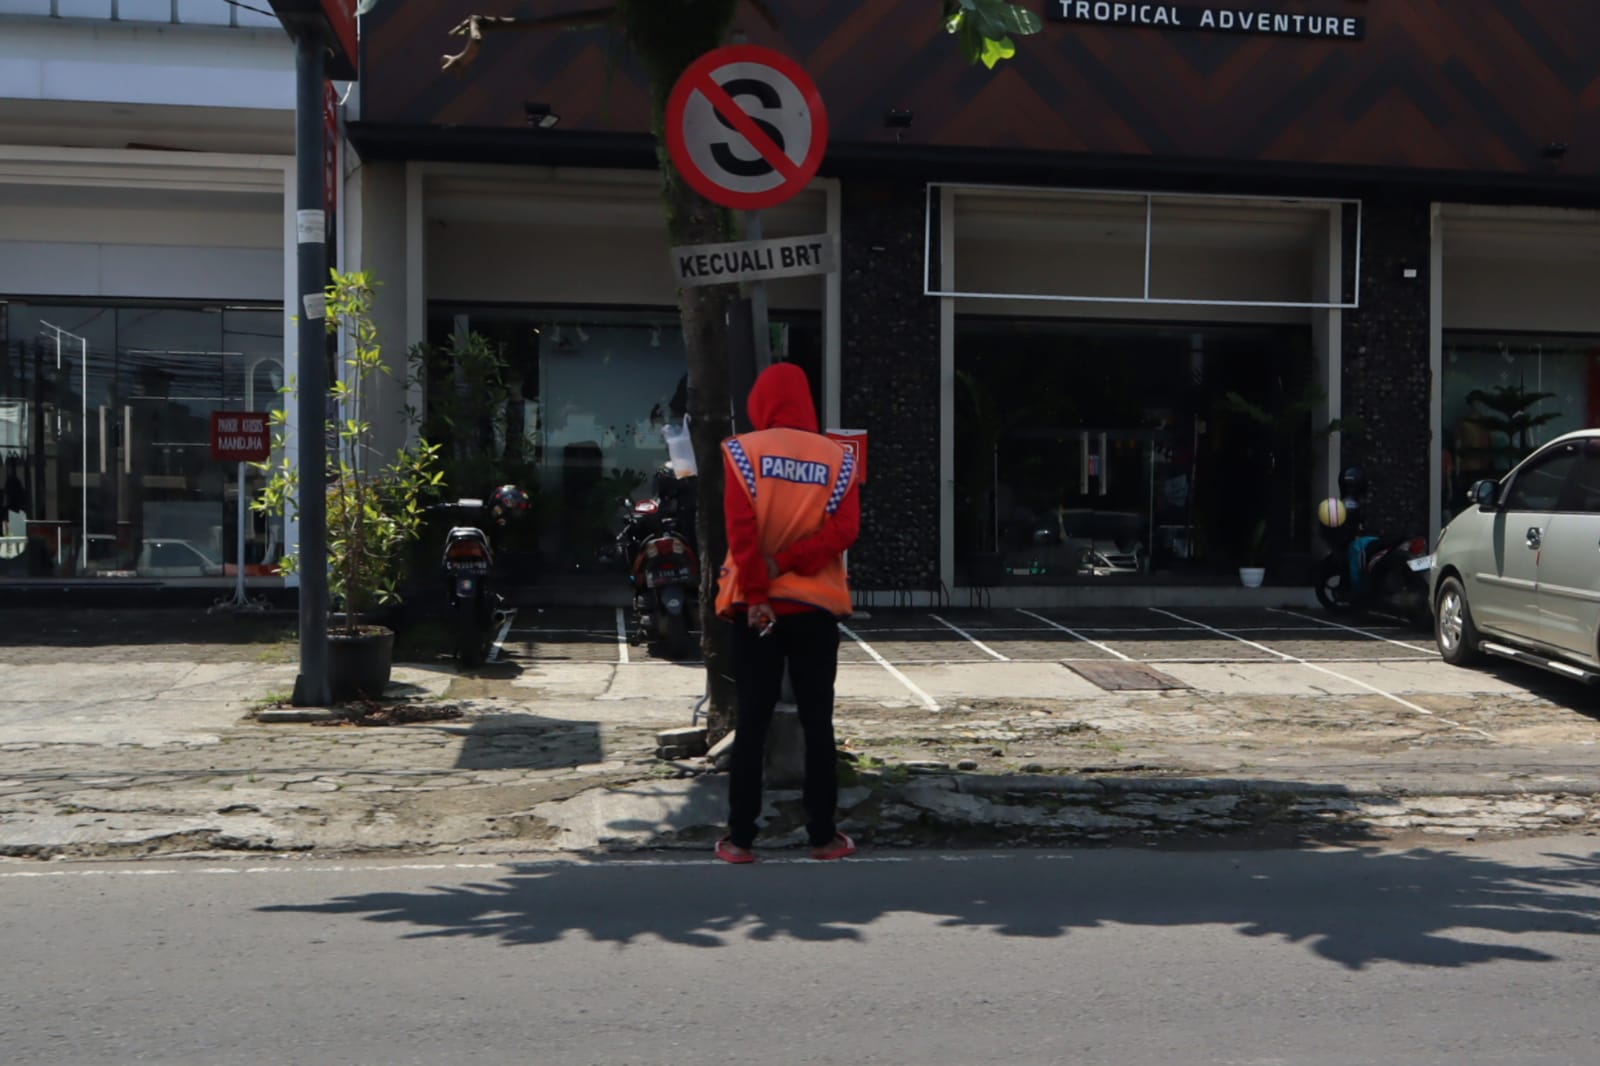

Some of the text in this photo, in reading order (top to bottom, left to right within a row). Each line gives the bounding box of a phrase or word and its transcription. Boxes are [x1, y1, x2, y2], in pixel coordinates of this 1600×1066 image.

[1060, 0, 1356, 36] TROPICAL ADVENTURE
[679, 243, 822, 278] KECUALI BRT
[761, 457, 828, 485] PARKIR
